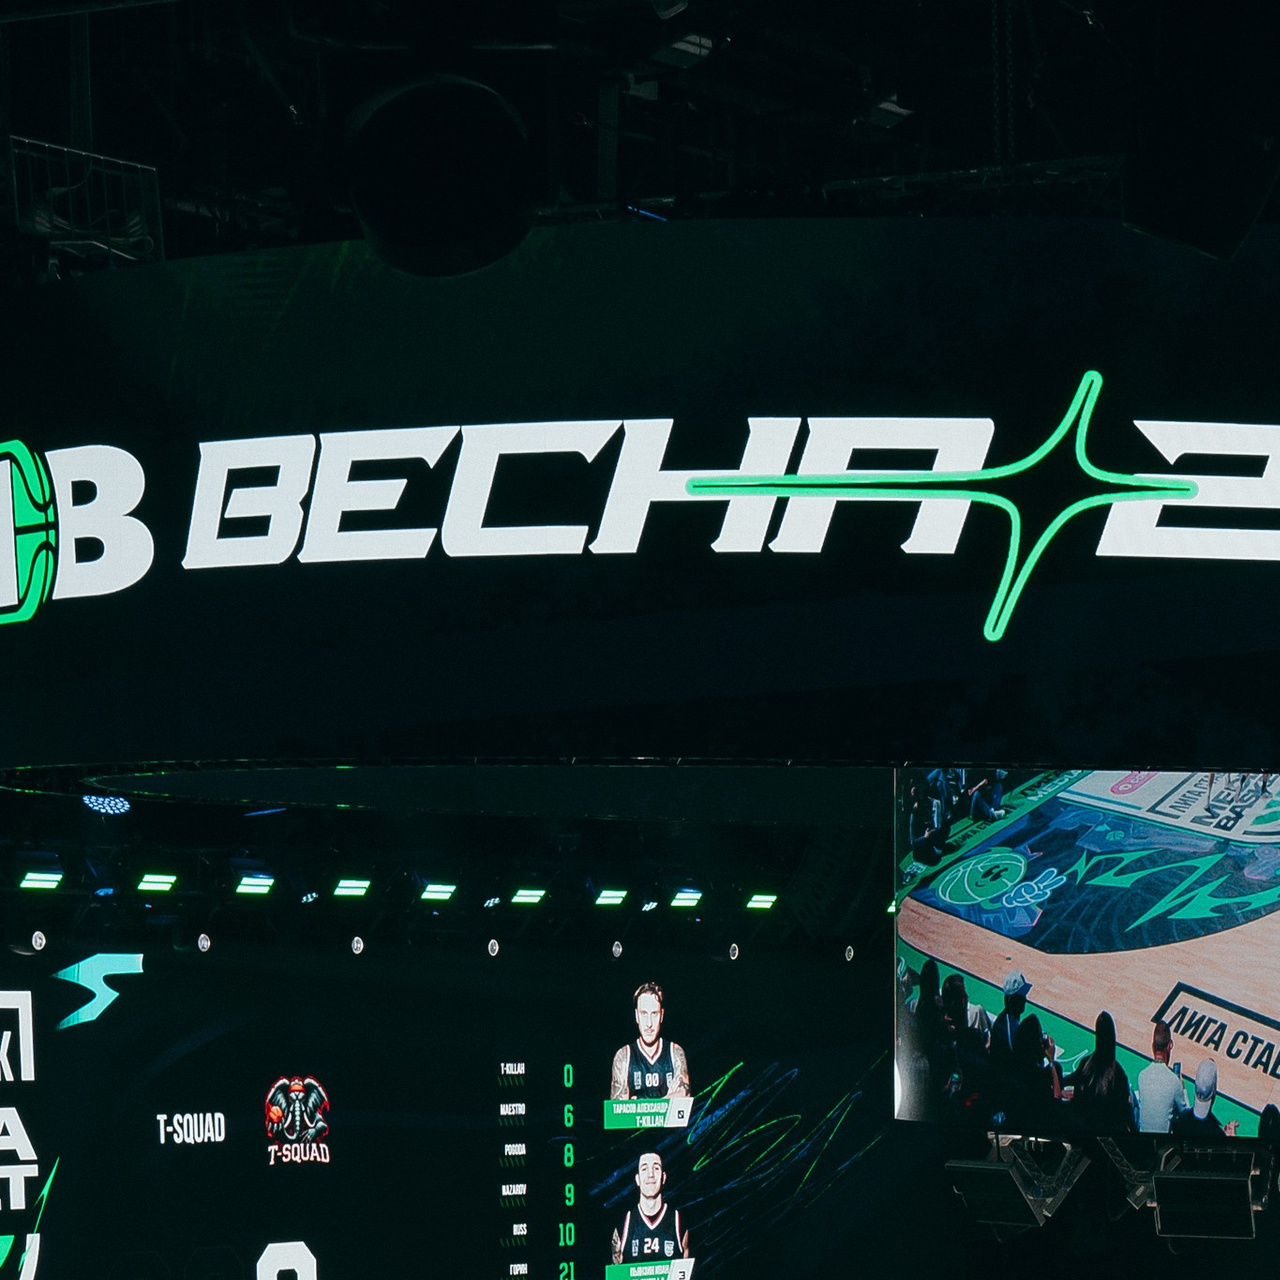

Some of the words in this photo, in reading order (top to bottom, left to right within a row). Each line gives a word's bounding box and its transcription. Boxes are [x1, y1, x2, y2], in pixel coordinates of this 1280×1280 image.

[182, 417, 995, 570] ВЕСНА
[1168, 1004, 1225, 1054] ЛИГА
[563, 1063, 574, 1088] 0
[157, 1112, 226, 1144] T-SQUAD
[563, 1103, 574, 1128] 6
[268, 1143, 330, 1166] T-SQUAD
[563, 1143, 575, 1167] 8
[564, 1183, 575, 1207] 9
[558, 1222, 575, 1247] 10
[643, 1236, 660, 1254] 24
